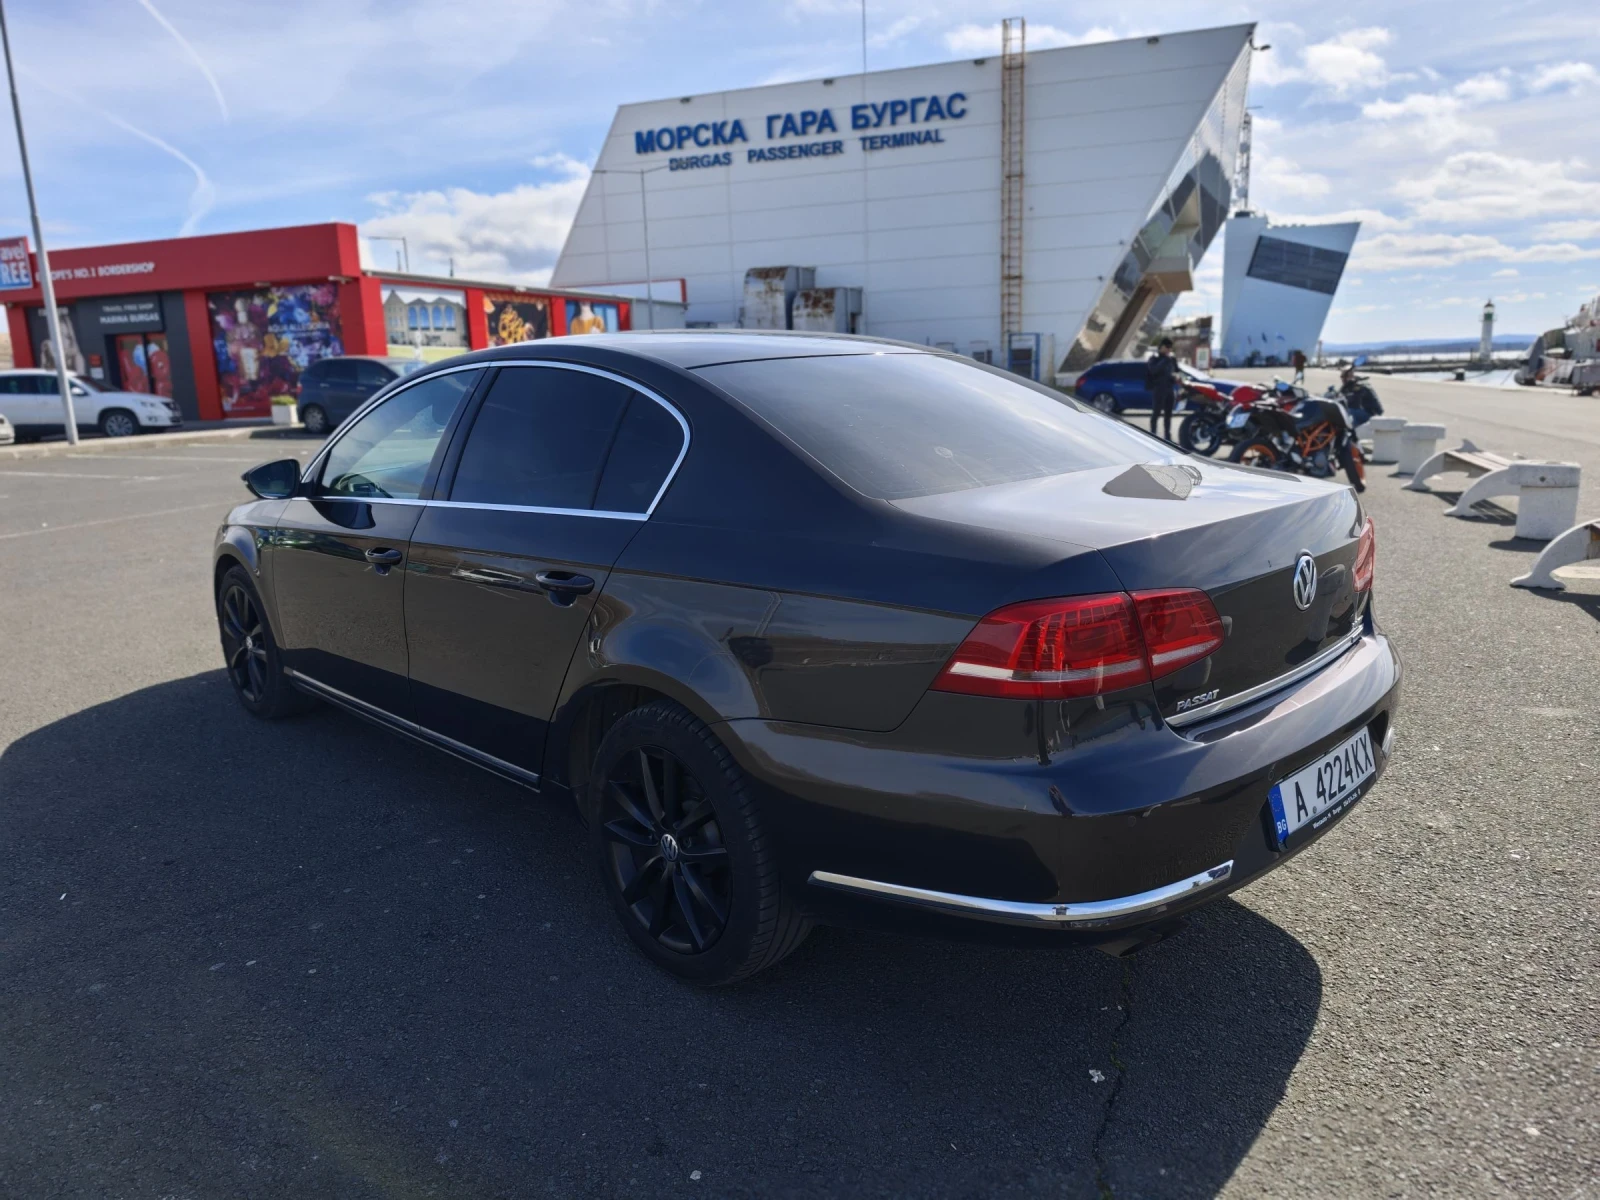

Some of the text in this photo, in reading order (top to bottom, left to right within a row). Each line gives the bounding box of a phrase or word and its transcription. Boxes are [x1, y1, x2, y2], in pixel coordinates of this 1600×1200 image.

[635, 92, 967, 154] МОРСКА ГАРА БУРГАС
[669, 129, 945, 171] BURGAS PASSENGER TERMINAL
[98, 261, 155, 277] BORDERSHOP
[100, 311, 159, 324] MARINA BURGAS
[1176, 688, 1220, 711] PASSAT
[1277, 819, 1287, 834] BG
